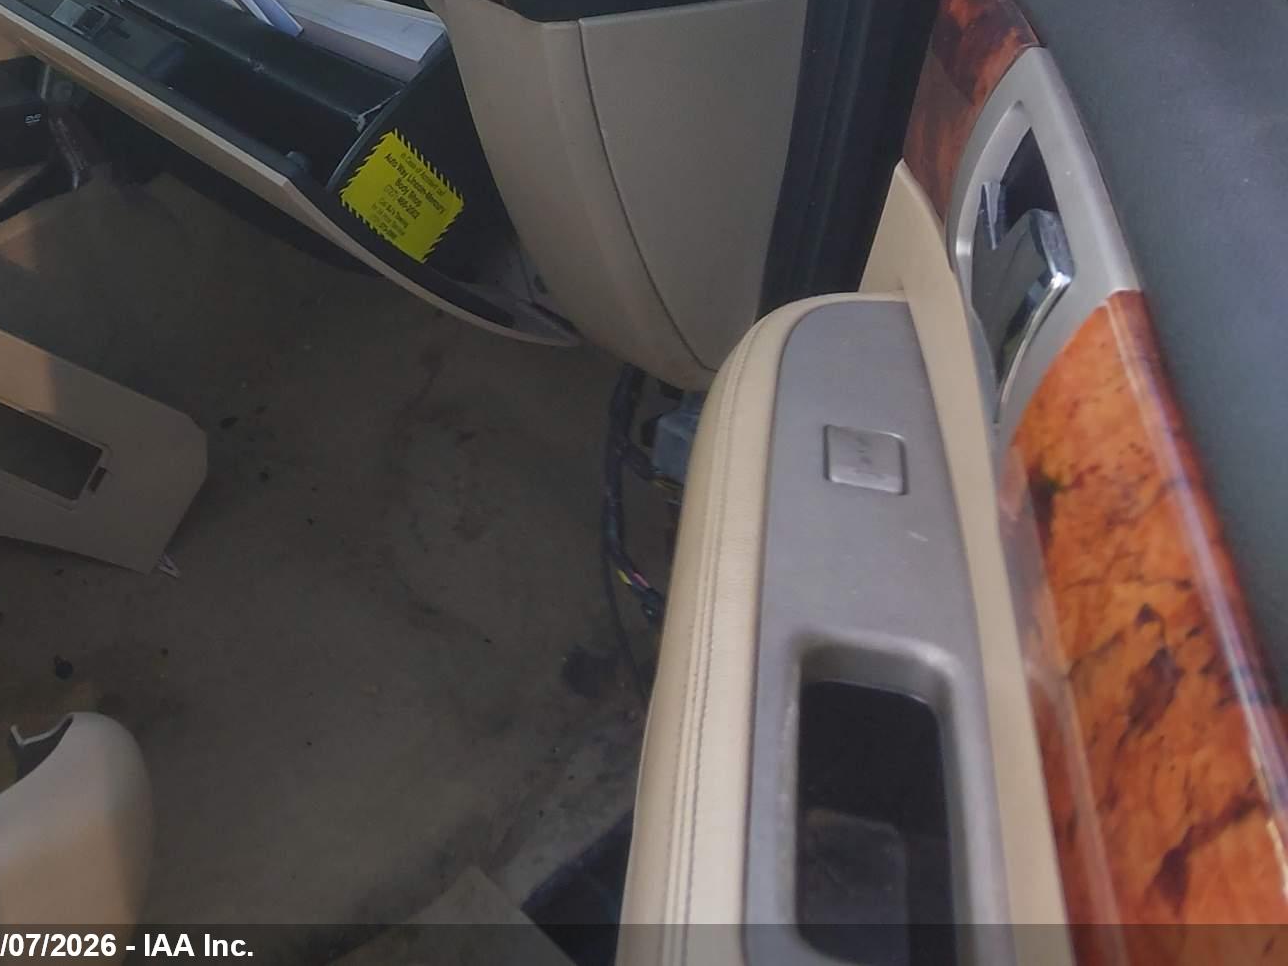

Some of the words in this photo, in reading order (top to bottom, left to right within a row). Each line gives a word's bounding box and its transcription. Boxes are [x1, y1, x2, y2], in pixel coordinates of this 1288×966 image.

[384, 152, 398, 168] Auto
[396, 165, 409, 179] Way
[394, 178, 409, 195] Body
